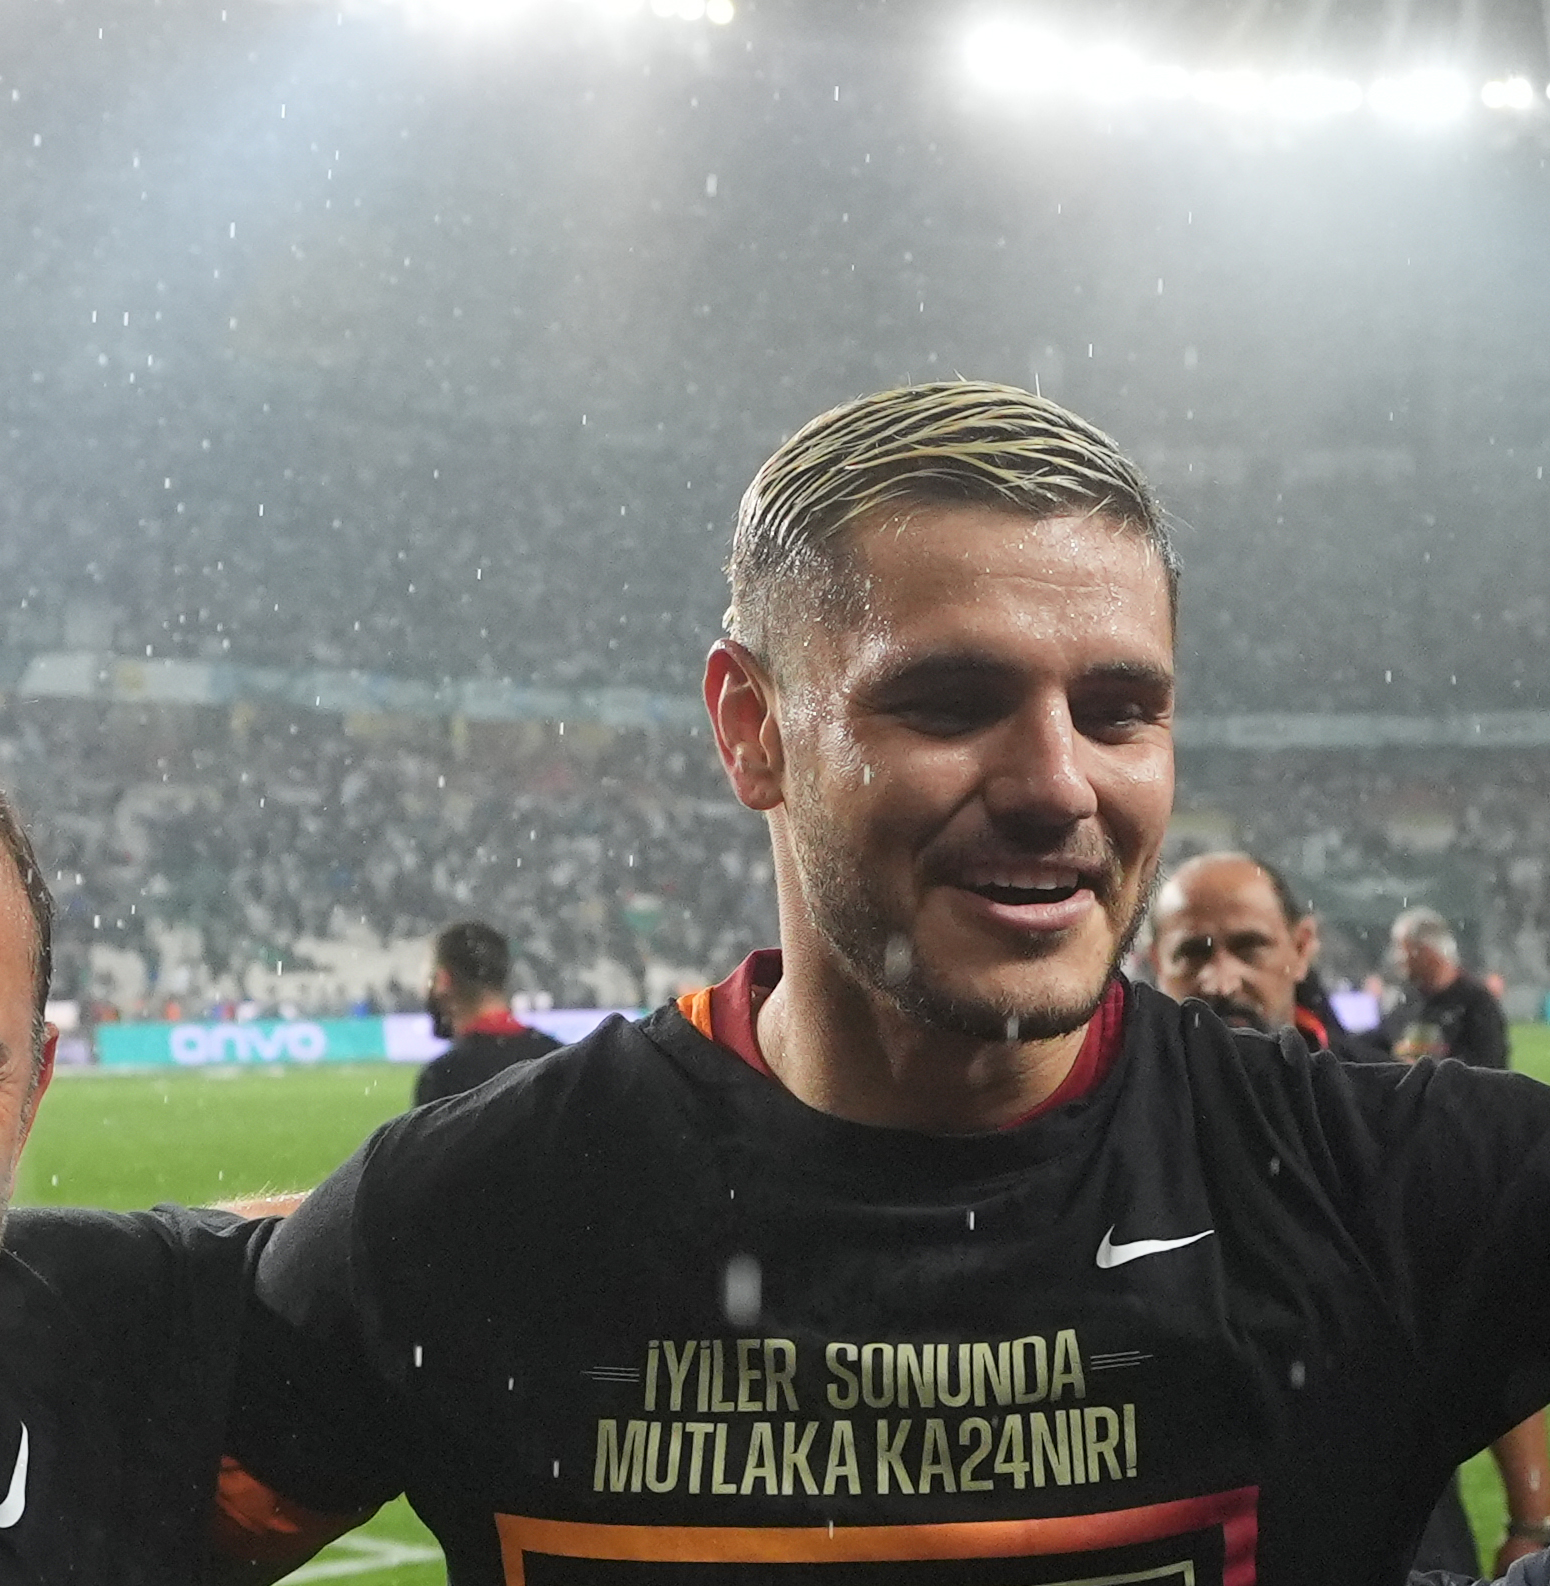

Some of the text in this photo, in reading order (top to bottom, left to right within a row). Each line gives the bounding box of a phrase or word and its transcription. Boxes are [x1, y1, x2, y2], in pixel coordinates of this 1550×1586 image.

[643, 1328, 1087, 1413] İYİLER SONUNDA
[593, 1403, 1139, 1495] MUTLAKA KA24NIR!
